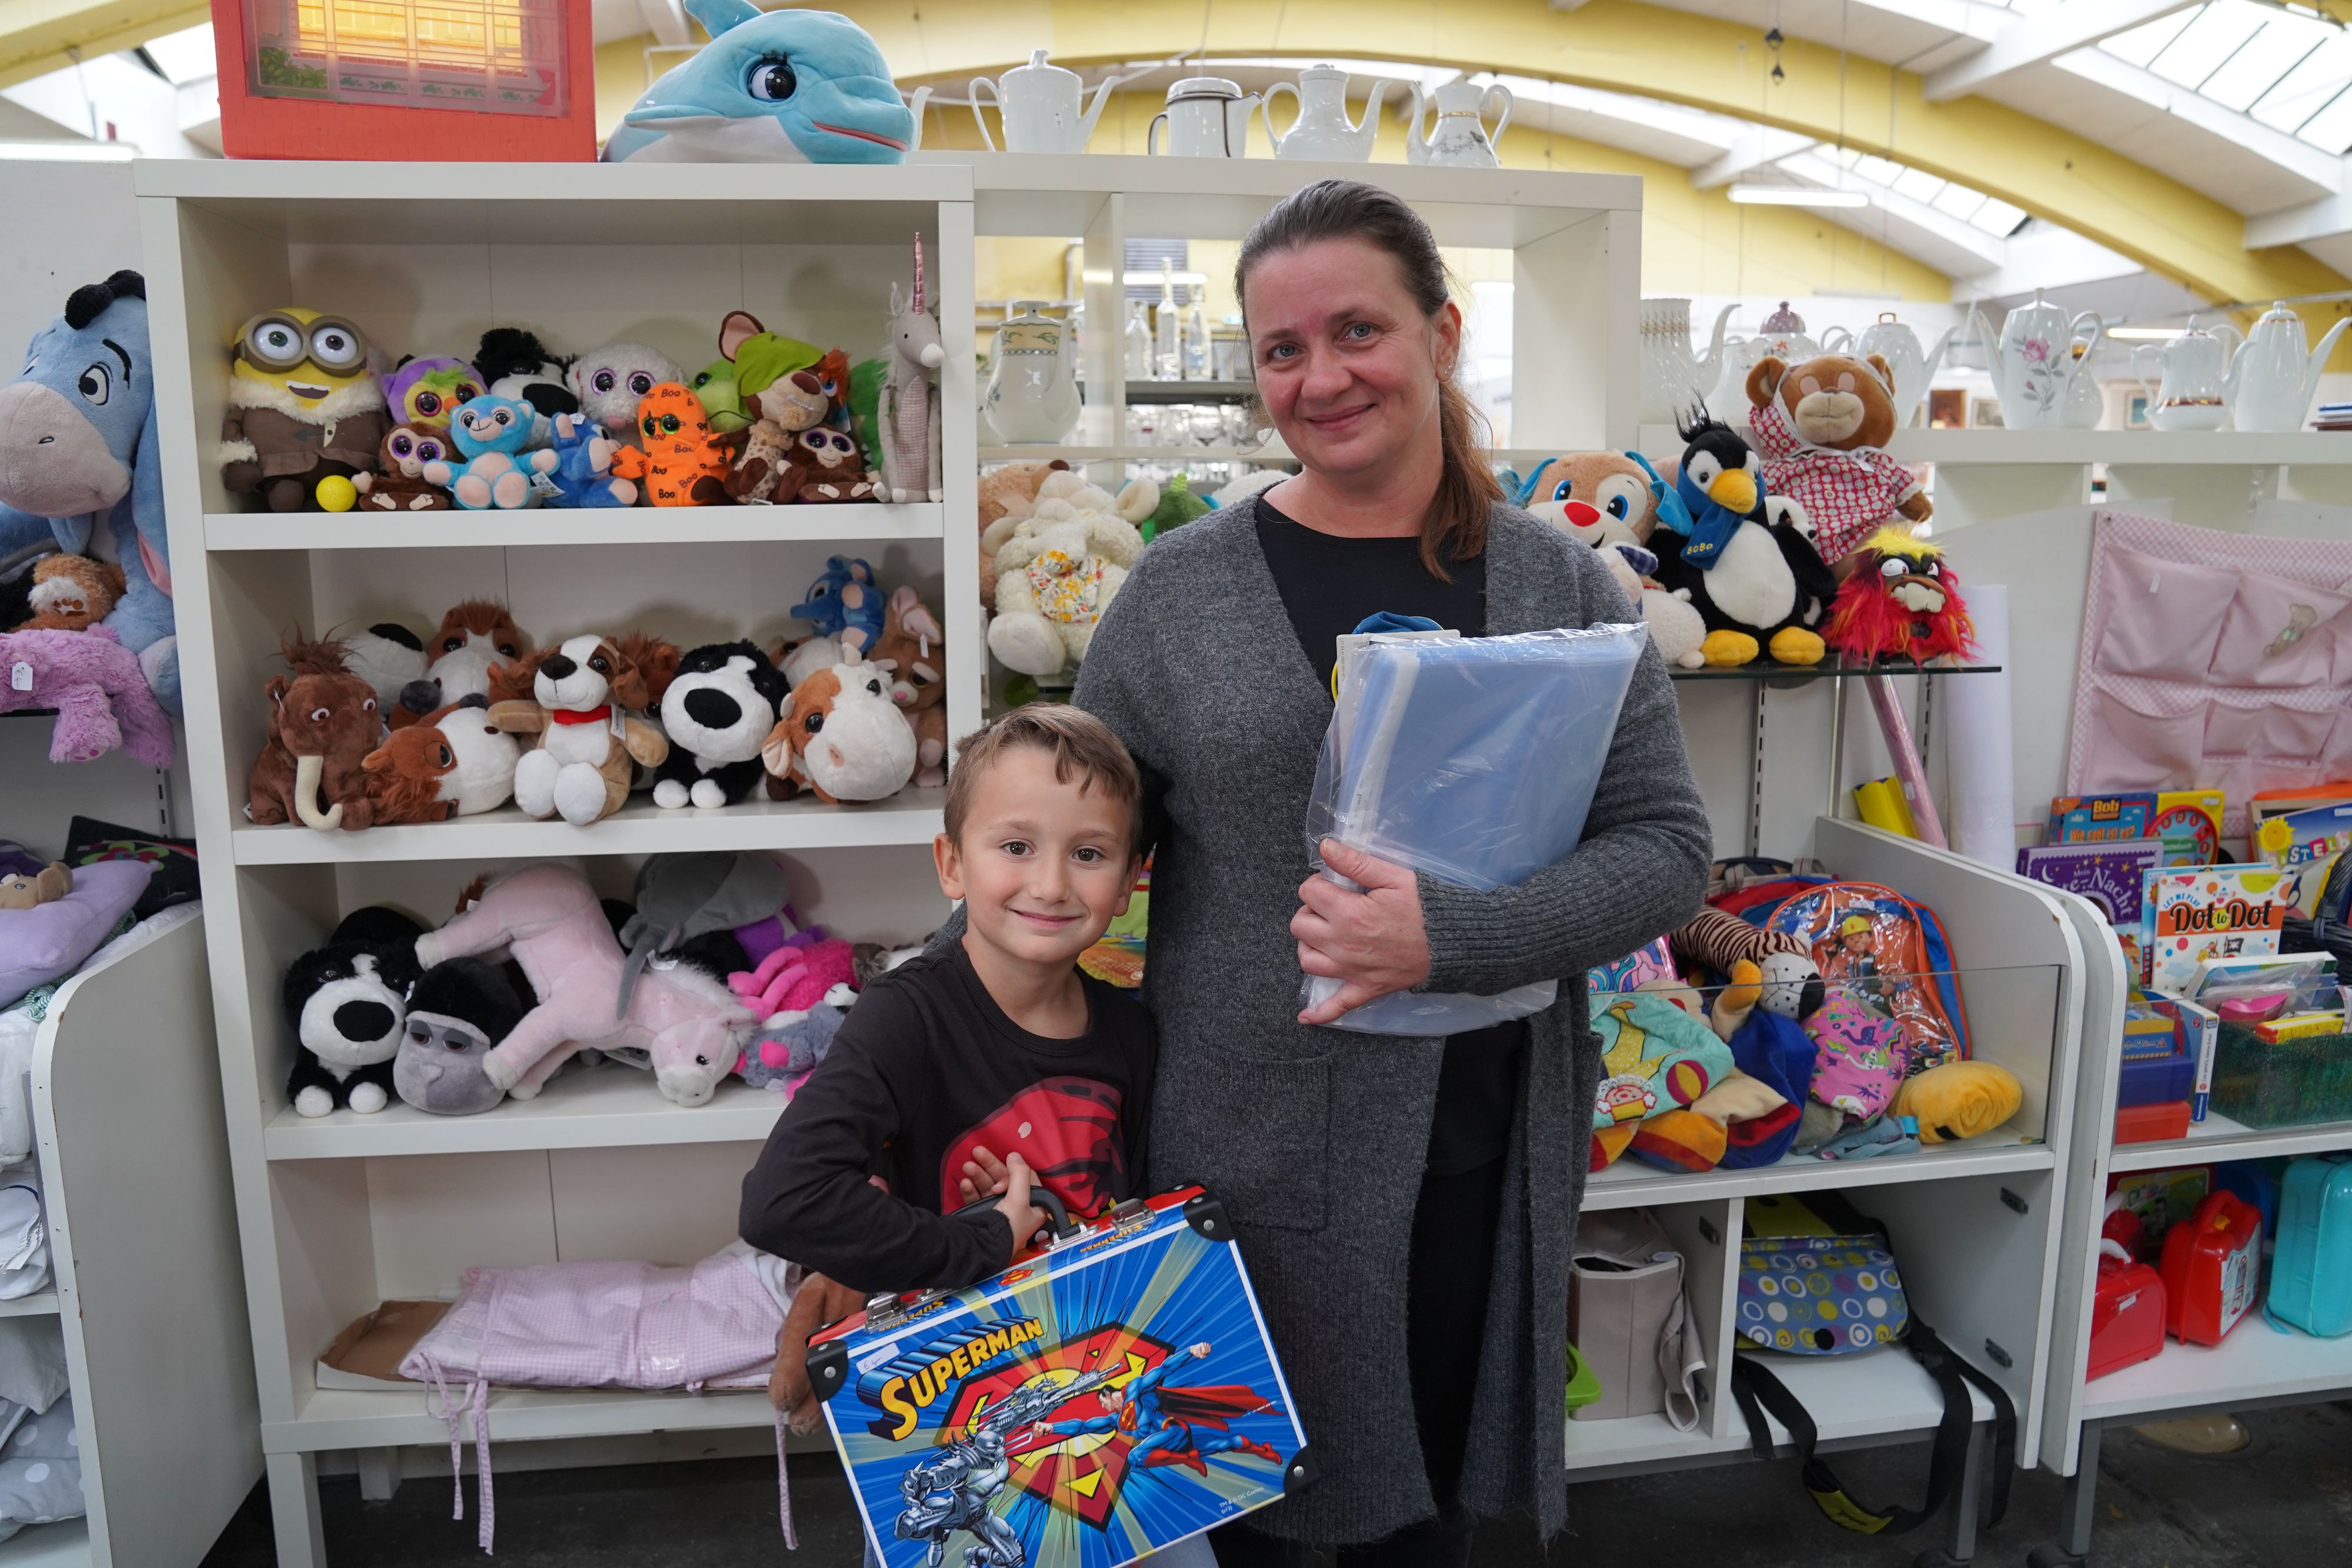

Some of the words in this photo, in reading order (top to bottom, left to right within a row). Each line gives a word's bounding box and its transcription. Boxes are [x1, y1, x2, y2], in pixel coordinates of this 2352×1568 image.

[661, 389, 681, 397] Boo
[651, 465, 667, 475] Boo
[679, 473, 698, 489] Boo
[659, 489, 675, 499] Boo
[2093, 798, 2120, 813] Bob
[2073, 869, 2090, 878] Mein
[2163, 897, 2174, 909] LET
[2186, 894, 2201, 907] PLAY
[2170, 901, 2216, 932] Dot
[2226, 899, 2273, 929] Dot
[878, 1298, 945, 1332] SUPERMAN
[880, 1318, 1044, 1442] SUPERMAN
